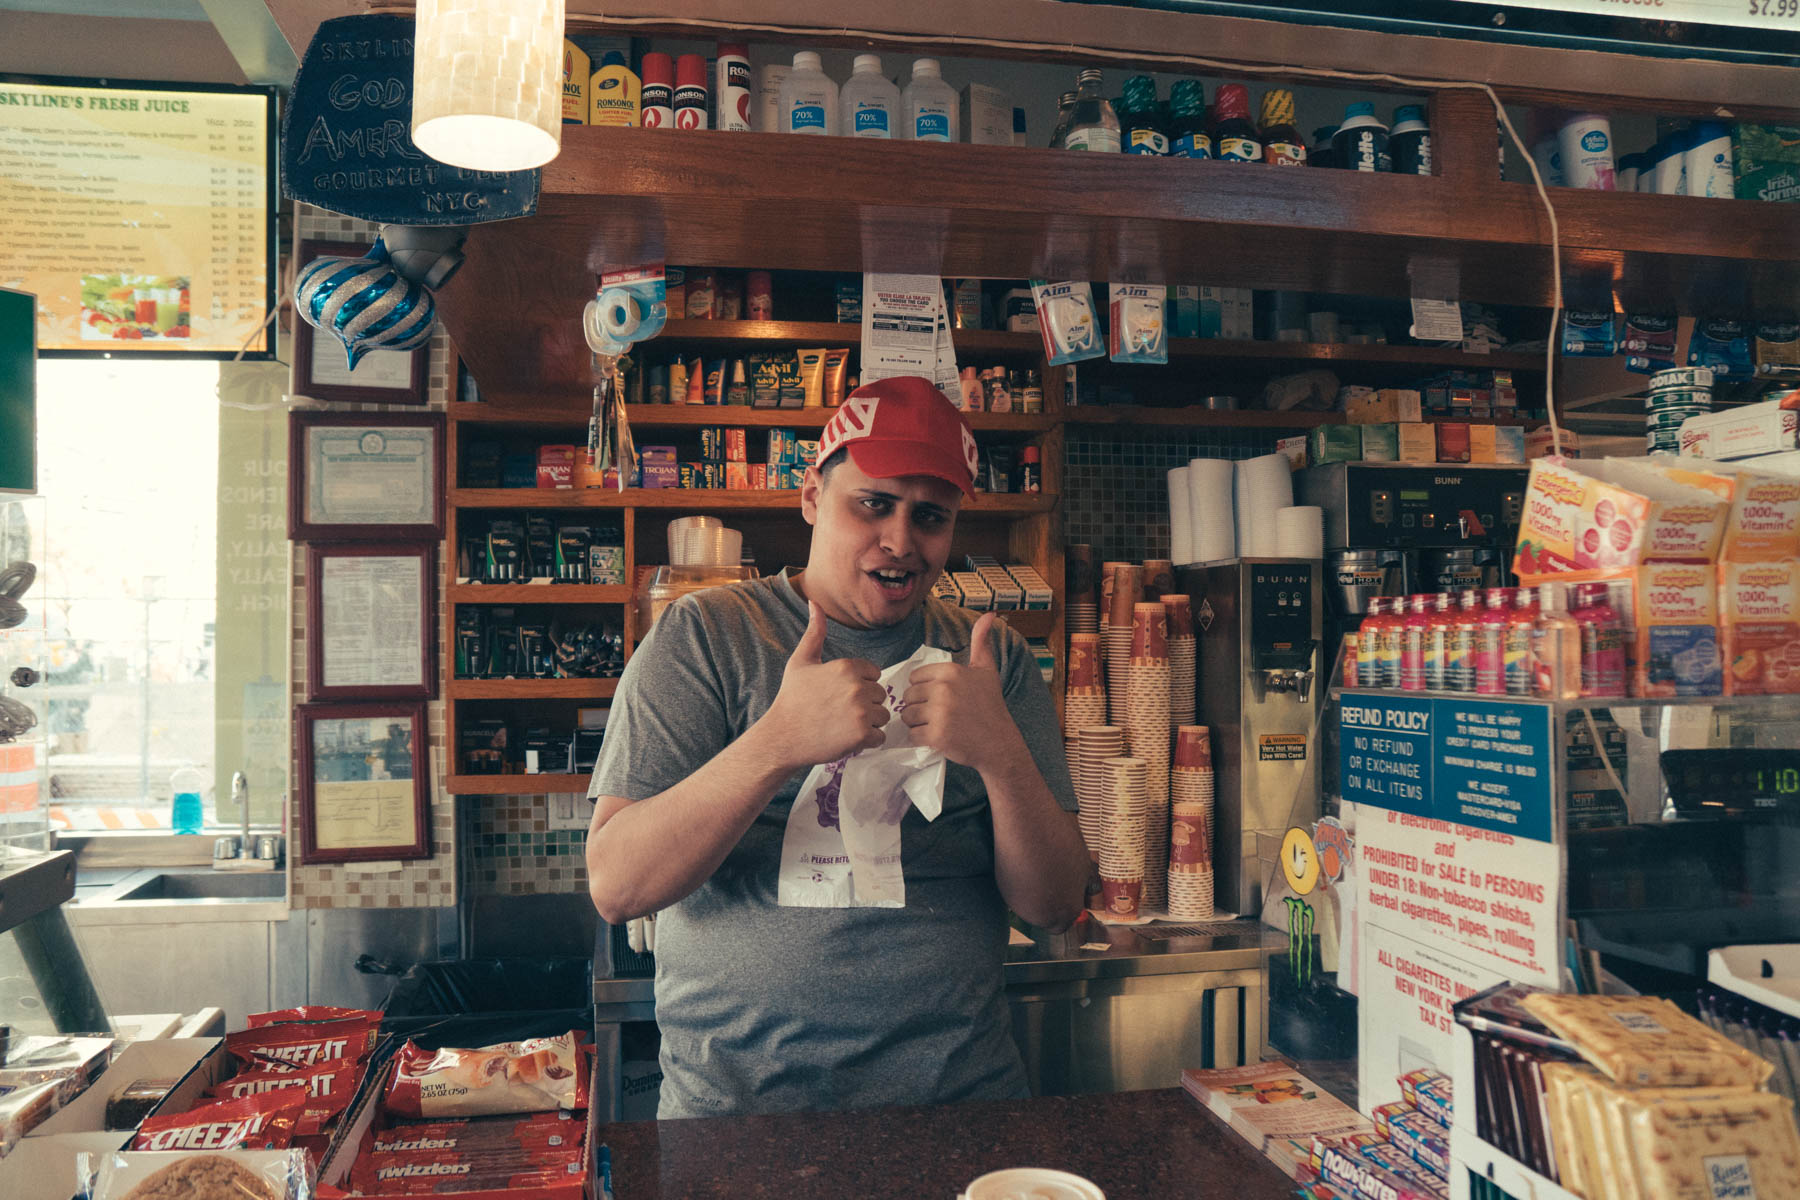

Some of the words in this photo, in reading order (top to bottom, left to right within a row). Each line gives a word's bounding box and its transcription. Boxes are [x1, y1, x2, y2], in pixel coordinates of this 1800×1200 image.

[322, 38, 415, 61] SKYLIN
[729, 66, 750, 77] RON
[643, 89, 668, 98] ONSON
[675, 90, 705, 99] ONSON
[0, 92, 84, 110] SKYLINE'S
[89, 97, 140, 112] FRESH
[144, 99, 190, 113] JUICE
[597, 98, 635, 109] RONSONOL
[795, 111, 813, 119] 70%
[858, 113, 877, 121] 70%
[919, 119, 938, 127] 70%
[297, 115, 423, 165] AMER
[313, 164, 439, 191] GOURMET
[1767, 172, 1795, 190] Irish
[426, 192, 481, 213] NYC
[603, 275, 623, 284] Utility
[624, 273, 640, 281] Tape
[1040, 285, 1071, 298] Aim
[1115, 286, 1148, 297] Aim
[1068, 325, 1085, 333] Aim
[757, 362, 792, 375] Advil
[781, 376, 801, 384] Advil
[1649, 372, 1689, 389] ODIAK
[538, 465, 571, 473] TROJAN
[644, 466, 677, 474] TROJAN
[1434, 477, 1461, 485] BUNN
[1528, 513, 1561, 538] Vitamin
[1563, 529, 1570, 542] C
[1740, 520, 1785, 530] Vitamin
[1785, 520, 1795, 530] C
[1652, 540, 1697, 551] Vitamin
[1698, 540, 1707, 551] C
[1650, 606, 1697, 617] Vitamin
[1699, 605, 1707, 617] C
[1737, 604, 1781, 615] Vitamin
[1782, 603, 1791, 615] C
[1341, 706, 1382, 727] REFUND
[1386, 710, 1429, 731] POLICY
[1455, 712, 1467, 722] WE
[1467, 713, 1485, 724] WILL
[1485, 714, 1497, 725] BE
[1497, 715, 1522, 727] HAPPY
[1456, 724, 1467, 735] TO
[1468, 725, 1499, 738] PROCESS
[1500, 729, 1521, 740] YOUR
[1354, 736, 1368, 751] NO
[1372, 738, 1414, 757] REFUND
[1446, 736, 1470, 748] CREDIT
[1471, 739, 1490, 750] CARD
[1491, 741, 1534, 756] PURCHASES
[1349, 755, 1362, 769] OR
[1366, 757, 1421, 779] EXCHANGE
[1444, 755, 1475, 768] MINIMUM
[1475, 760, 1504, 773] CHARGE
[1505, 763, 1514, 774] IS
[1348, 773, 1361, 788] ON
[1365, 776, 1384, 794] ALL
[1389, 779, 1423, 801] ITEMS
[1467, 780, 1480, 791] WE
[1401, 812, 1452, 834] electronic
[1434, 841, 1455, 858] and
[811, 855, 834, 865] PLEASE
[1362, 845, 1418, 873] PROHIBITED
[1421, 858, 1435, 877] for
[1439, 862, 1466, 886] SALE
[1470, 869, 1481, 889] to
[1485, 873, 1545, 904] PERSONS
[1369, 868, 1400, 890] UNDER
[1402, 875, 1418, 896] 18:
[1420, 882, 1487, 914] Non-tobacco
[1490, 902, 1536, 930] shisha,
[1369, 889, 1399, 911] herbal
[1401, 900, 1456, 928] cigarettes,
[1458, 915, 1493, 944] pipes,
[1494, 927, 1536, 957] rolling
[1378, 948, 1394, 968] ALL
[1395, 956, 1452, 993] CIGARETTES
[1395, 975, 1416, 997] NEW
[1418, 985, 1443, 1010] YORK
[1419, 1005, 1437, 1027] TAX
[1440, 1015, 1454, 1036] ST
[421, 1084, 436, 1092] NET
[421, 1090, 437, 1099] 2.65
[437, 1089, 447, 1097] OZ
[448, 1087, 468, 1096] (75g)
[374, 1136, 458, 1151] Twizzlers
[376, 1162, 472, 1181] Twizzlers
